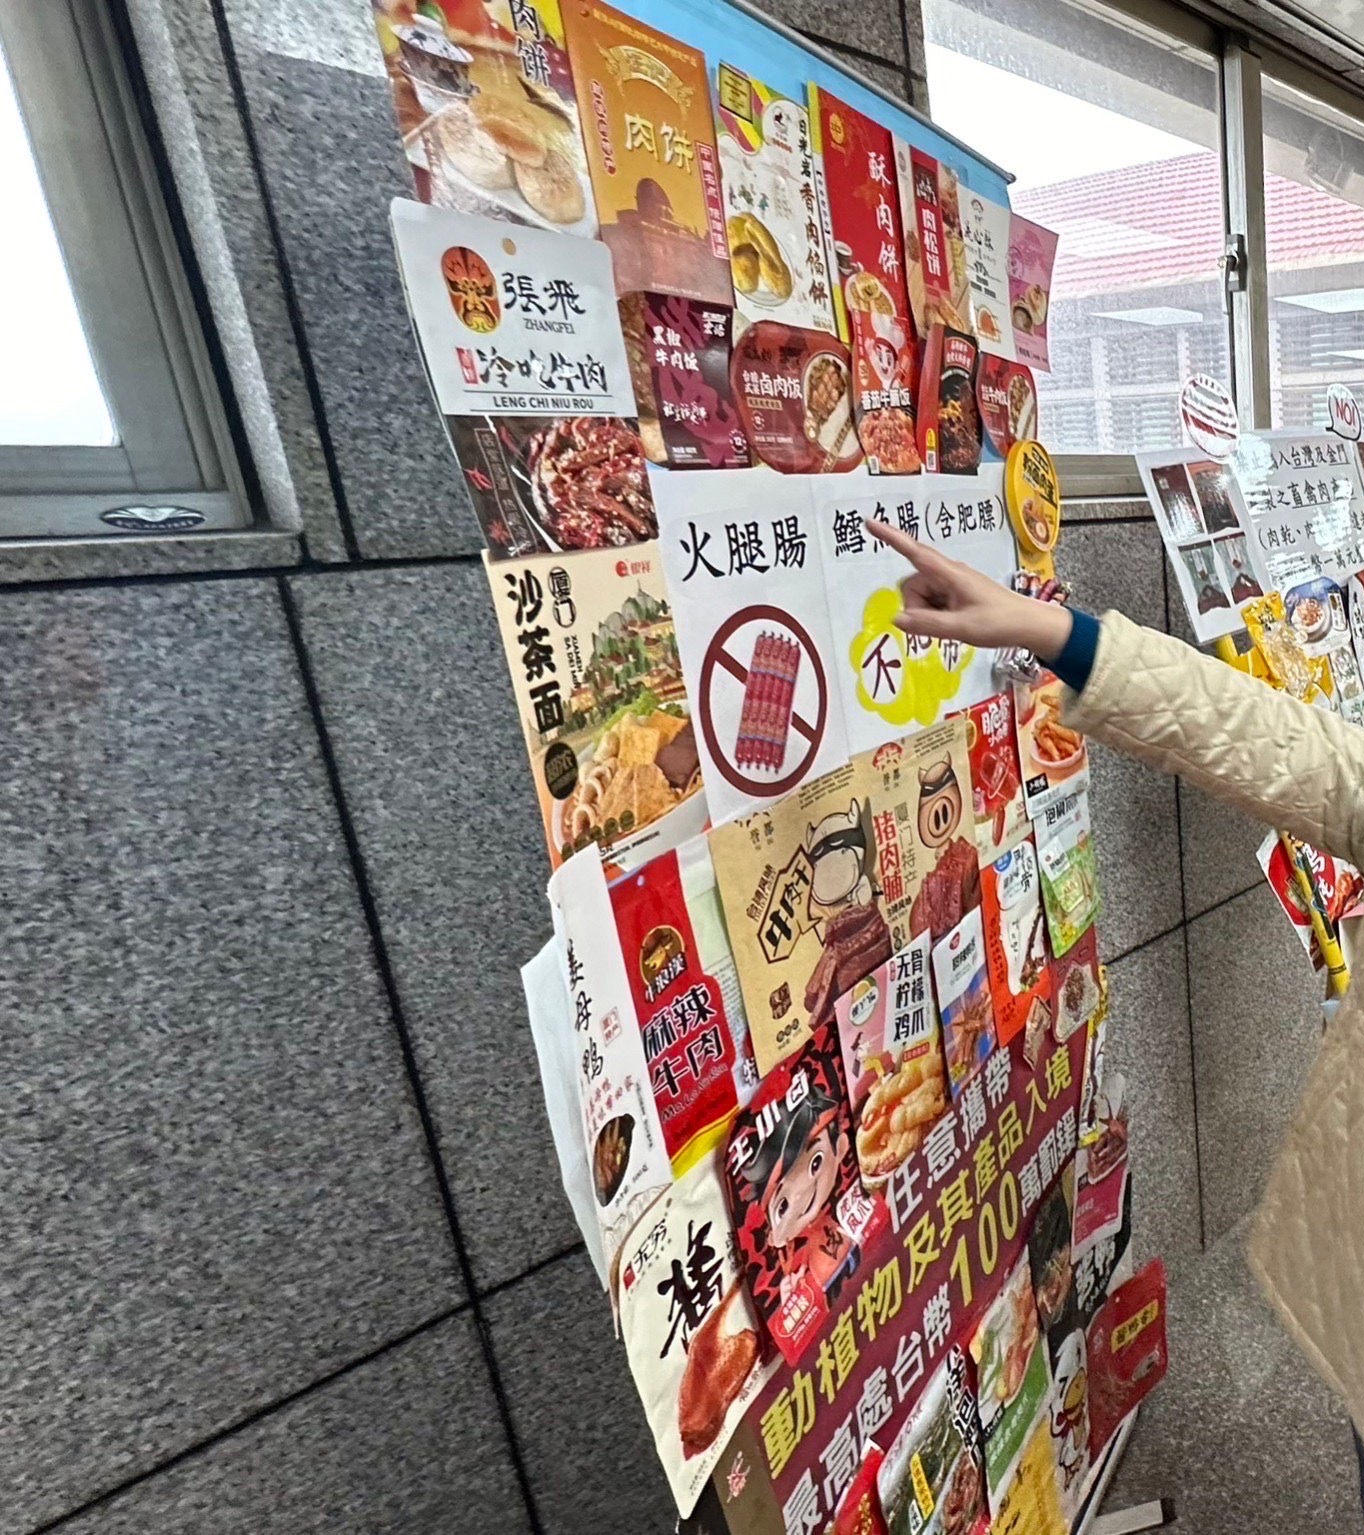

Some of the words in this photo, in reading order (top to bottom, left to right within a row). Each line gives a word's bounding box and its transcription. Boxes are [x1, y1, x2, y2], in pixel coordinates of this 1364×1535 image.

[624, 112, 695, 174] 肉饼
[867, 151, 899, 283] 酥肉饼
[501, 272, 586, 320] 張飛
[524, 318, 576, 335] ZHANGFEI
[652, 325, 681, 347] 黑椒
[475, 346, 609, 392] 冷吃牛肉
[655, 349, 699, 371] 牛肉饭
[759, 372, 803, 400] 卤肉饭
[494, 396, 526, 409] LENG
[528, 397, 549, 409] CHI
[551, 397, 570, 410] NIU
[573, 397, 594, 410] ROU
[679, 514, 808, 583] 火腿腸
[504, 568, 565, 735] 沙茶面
[873, 810, 907, 905] 猪肉脯
[895, 948, 923, 982] 无骨
[895, 976, 925, 1009] 柠檬
[642, 983, 717, 1063] 麻辣
[893, 1008, 926, 1042] 鸡爪
[652, 1025, 724, 1097] 牛肉
[728, 1068, 810, 1176] 王小卤
[885, 1046, 1013, 1234] 任意攜帶
[760, 1044, 1073, 1480] 動植物及其產品入境
